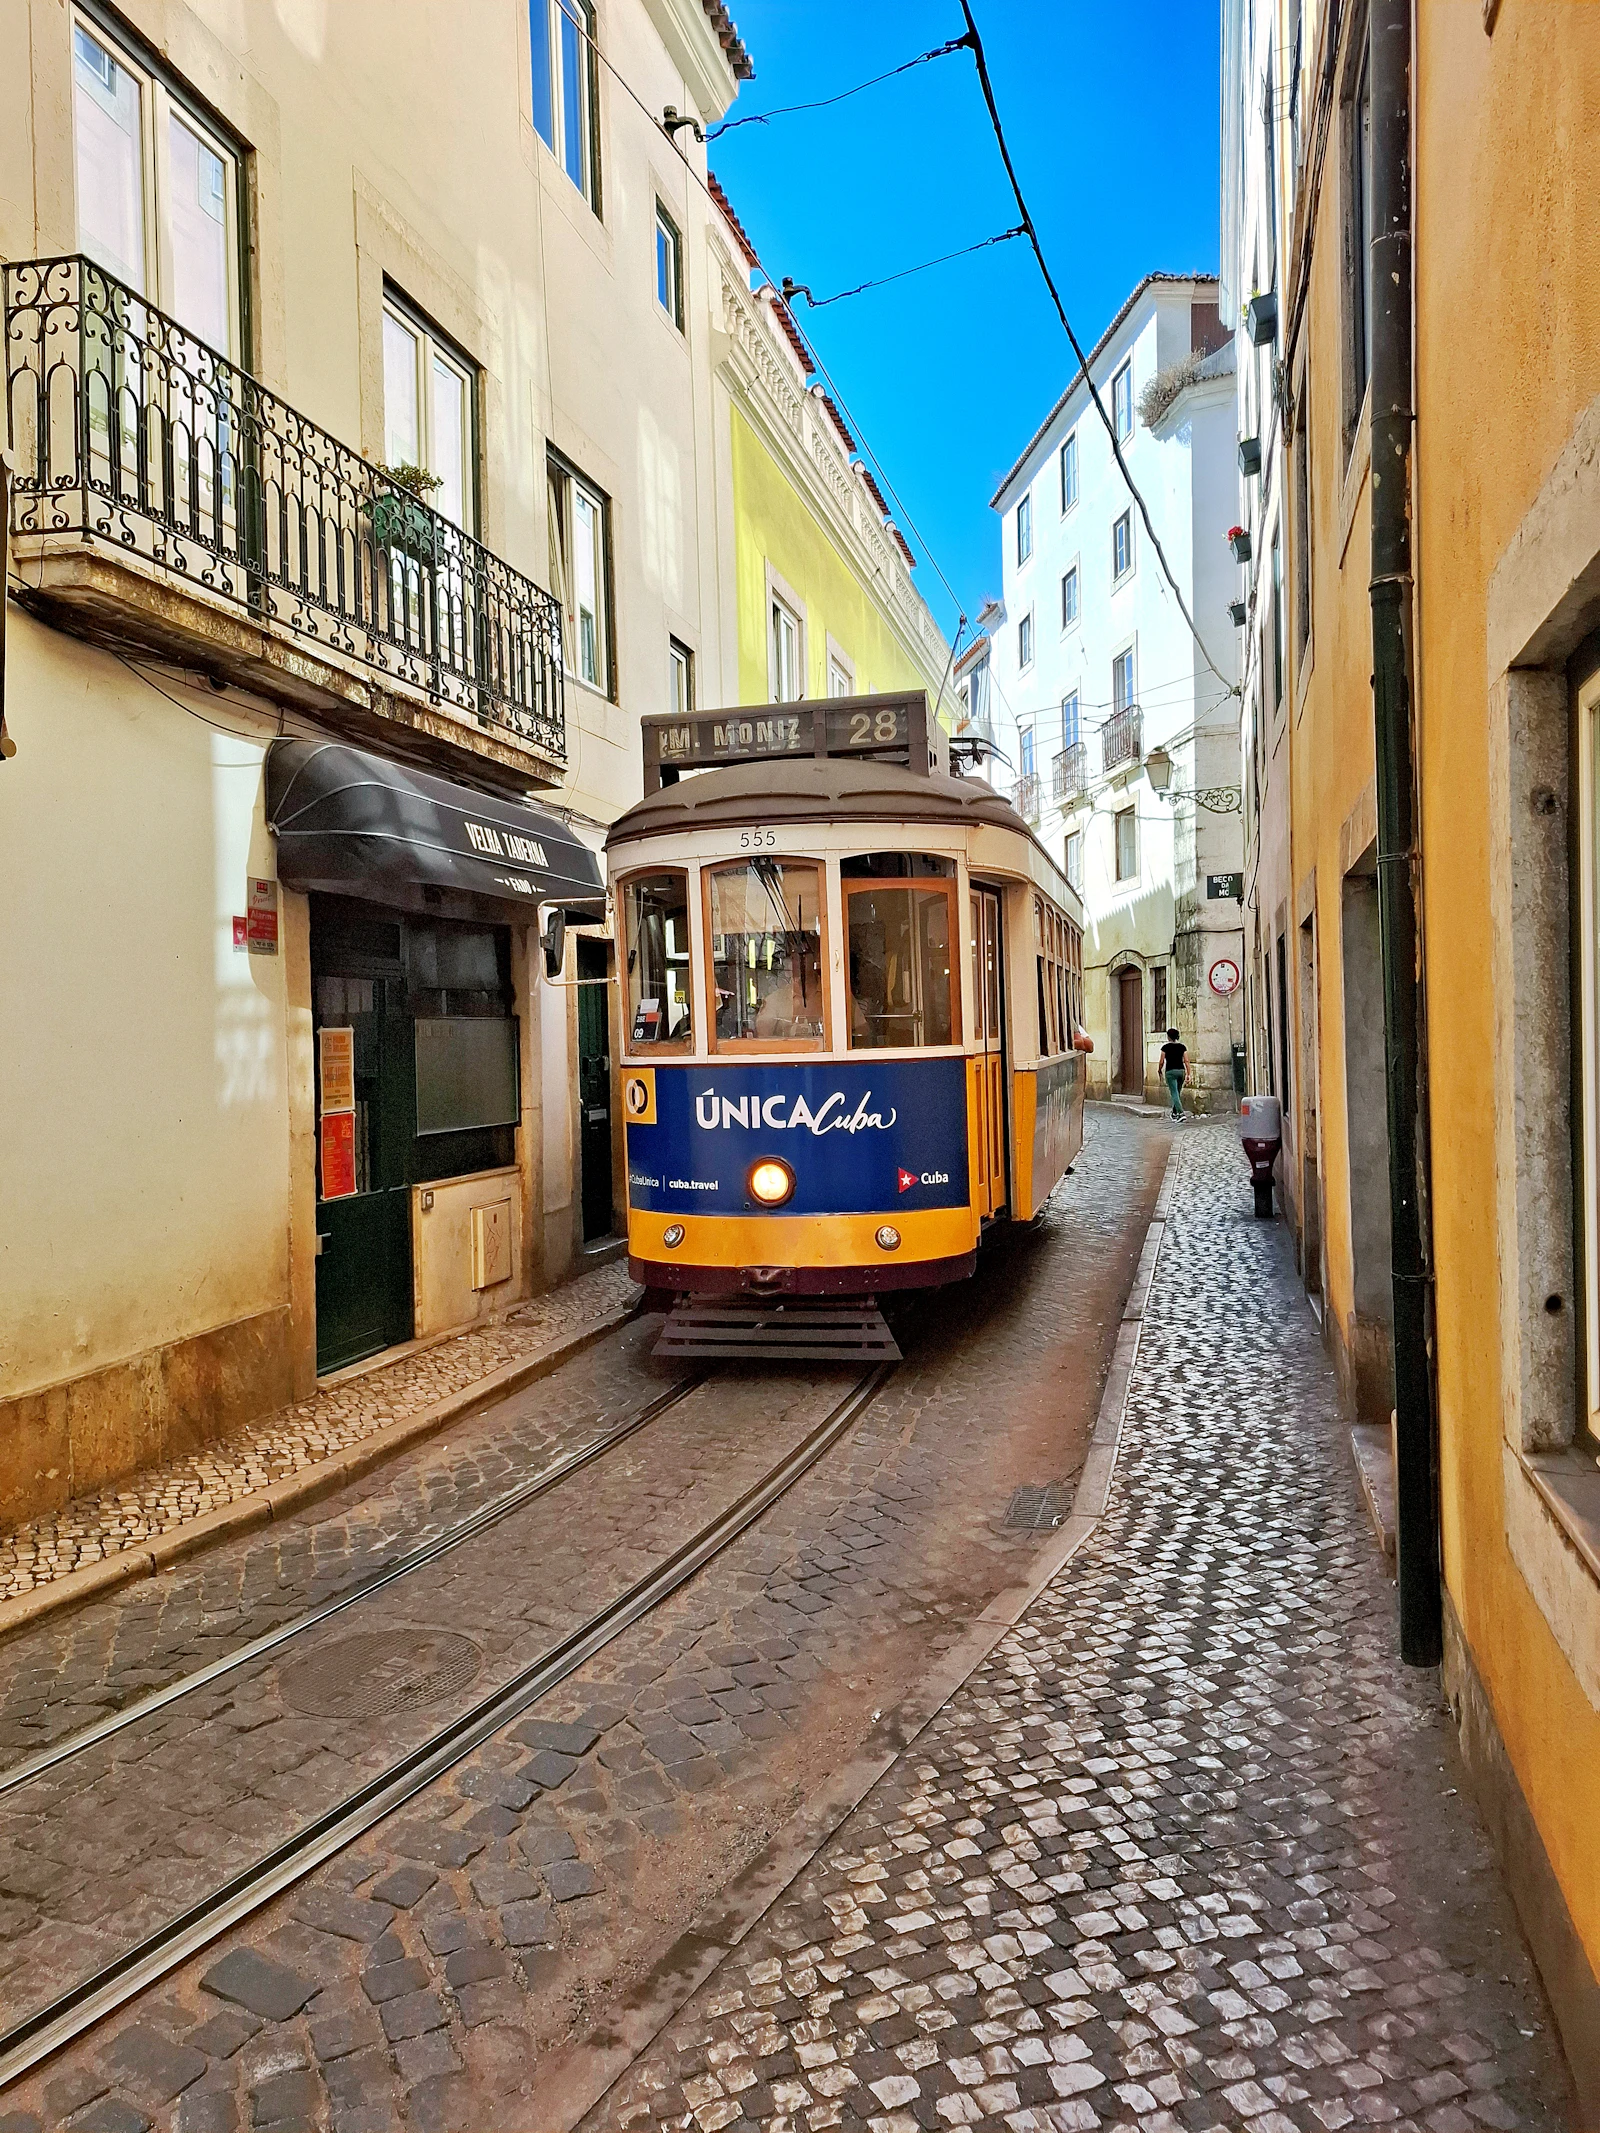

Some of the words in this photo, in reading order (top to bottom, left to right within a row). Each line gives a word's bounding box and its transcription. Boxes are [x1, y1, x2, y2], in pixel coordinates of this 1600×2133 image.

[713, 718, 801, 747] MONIZ
[850, 710, 898, 744] 28
[464, 822, 504, 855] VELHA
[502, 832, 549, 867] TABERNA
[740, 831, 776, 847] 555
[509, 877, 532, 894] FADO
[634, 1027, 644, 1038] 09
[696, 1087, 813, 1129] ÚNICA
[812, 1090, 897, 1136] Cuba
[669, 1179, 719, 1190] cuba.travel
[920, 1171, 949, 1185] Cuba
